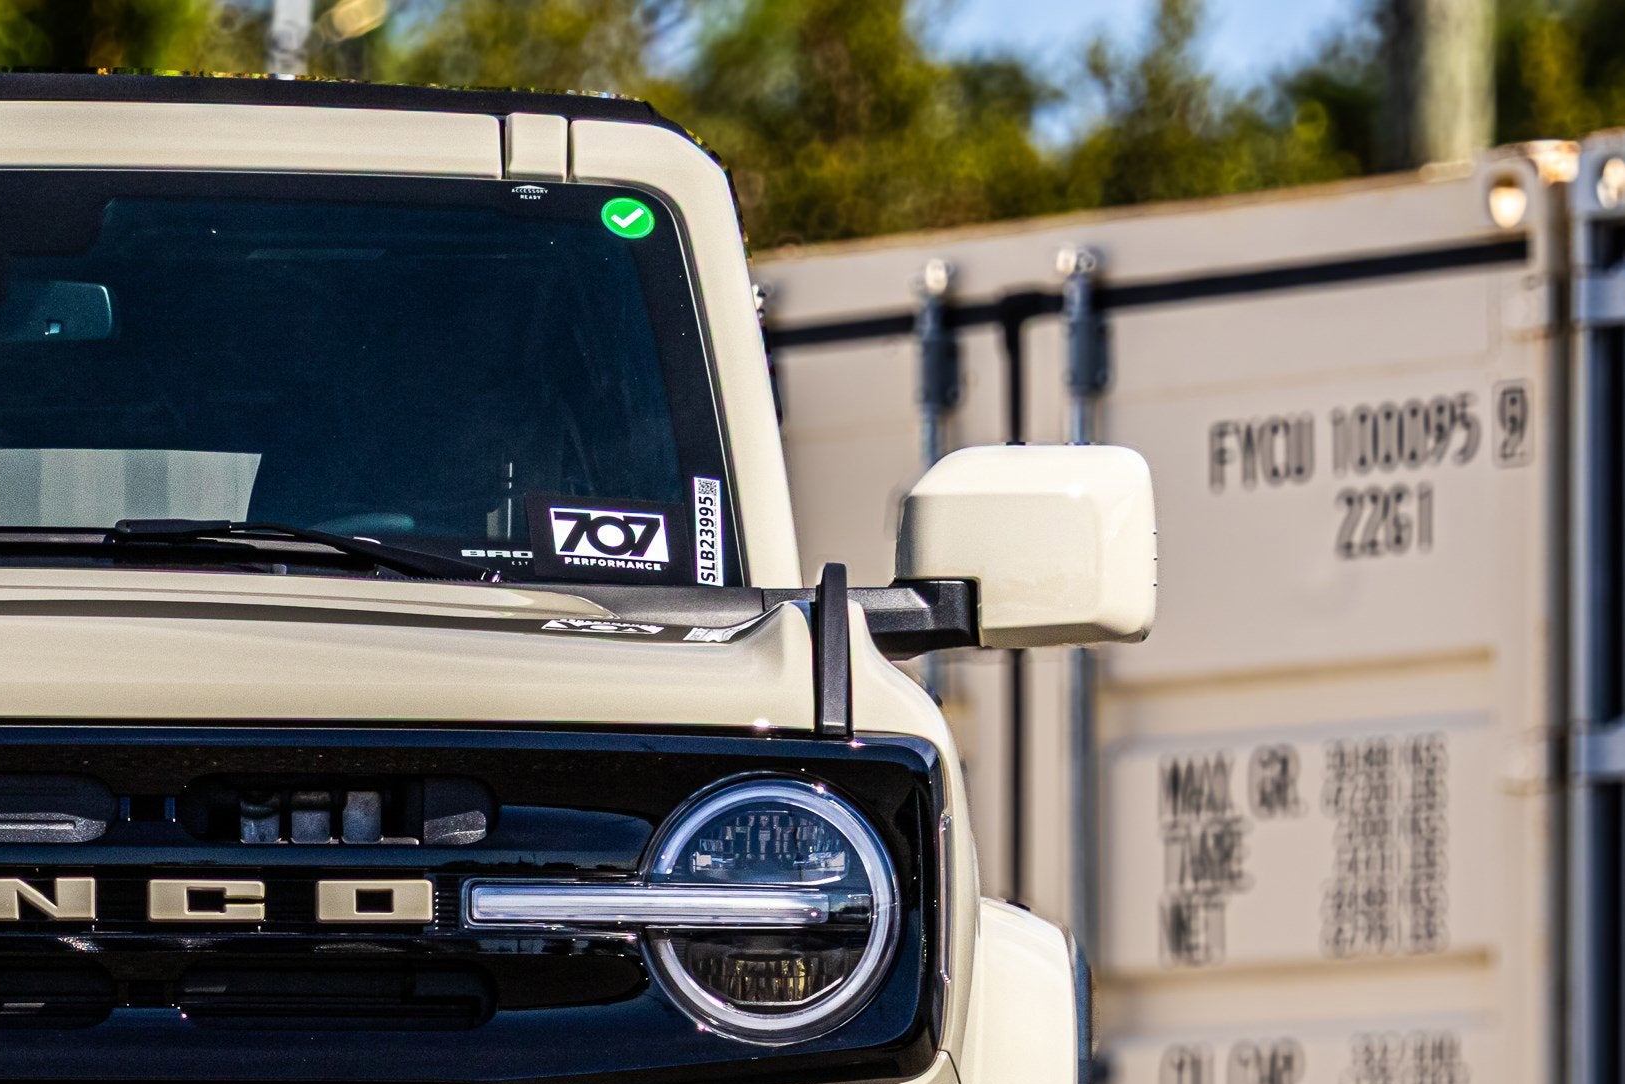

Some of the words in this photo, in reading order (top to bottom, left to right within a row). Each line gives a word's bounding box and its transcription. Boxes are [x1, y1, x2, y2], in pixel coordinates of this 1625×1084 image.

[554, 511, 661, 558] 707
[698, 496, 716, 583] SLB23995
[461, 549, 533, 559] BRO
[564, 556, 662, 571] PERFORMANCE
